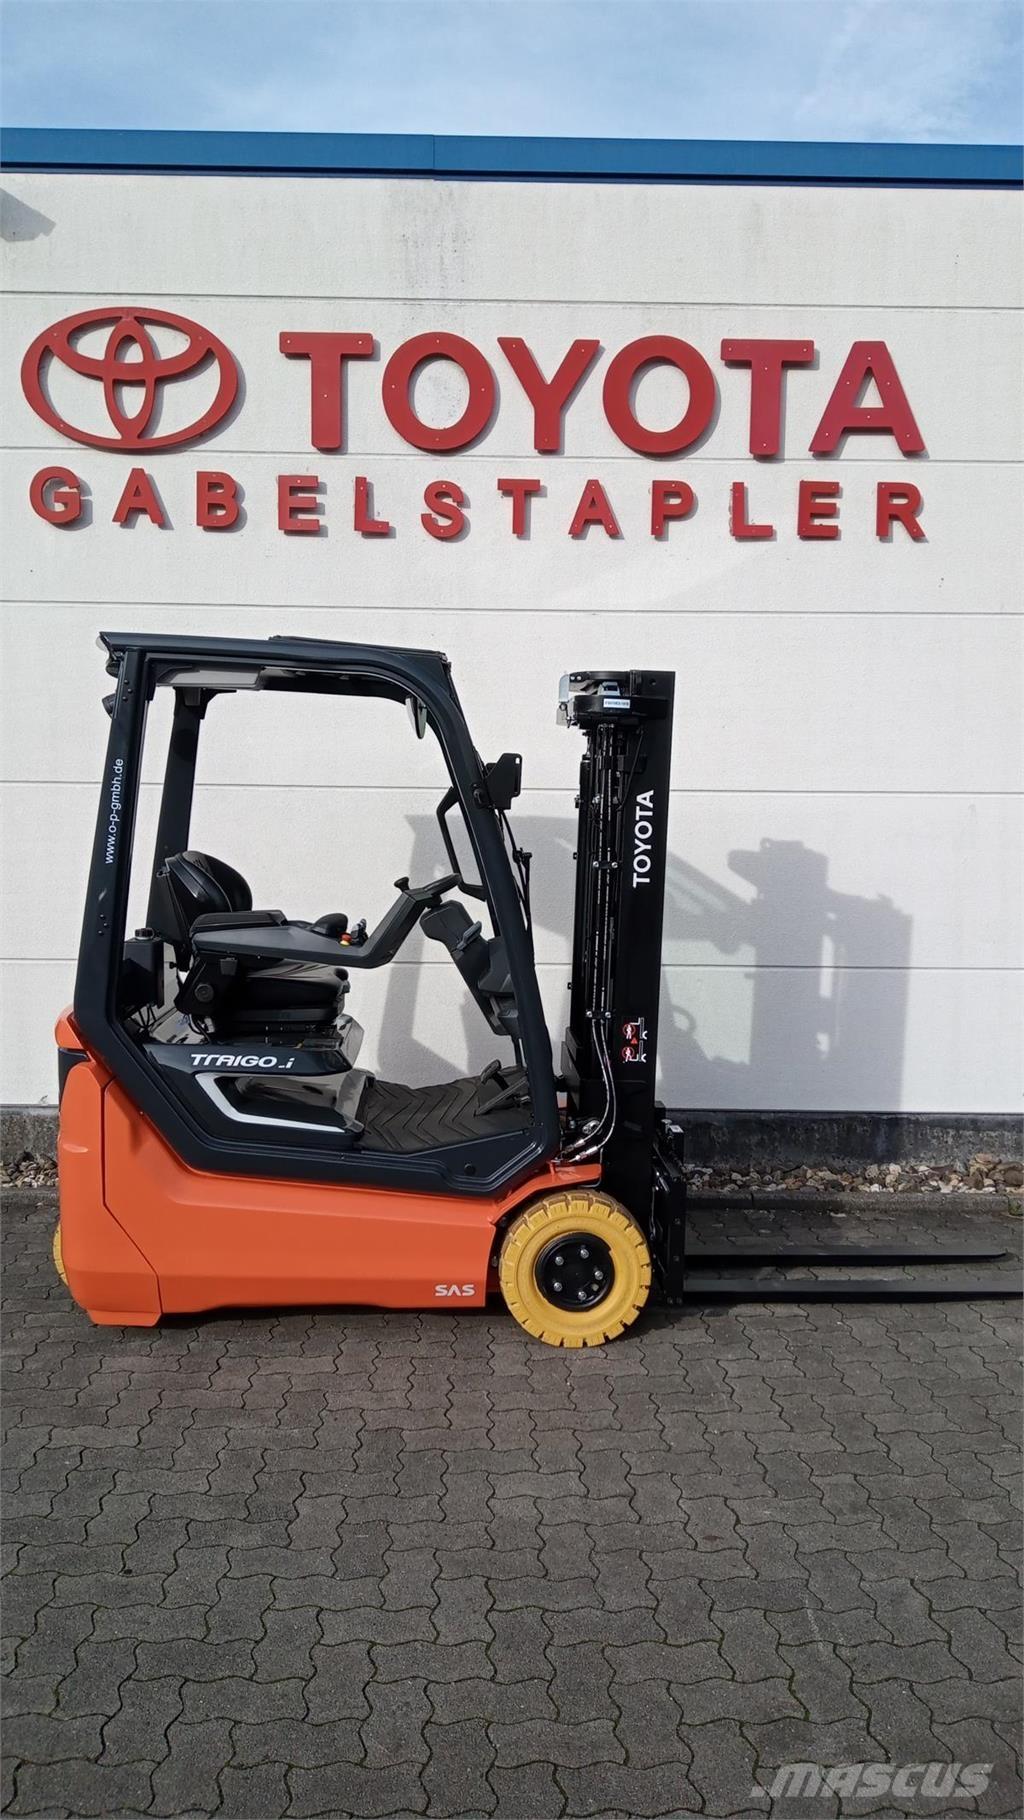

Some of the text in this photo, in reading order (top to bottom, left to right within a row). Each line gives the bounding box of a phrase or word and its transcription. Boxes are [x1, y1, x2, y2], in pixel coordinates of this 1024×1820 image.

[279, 331, 926, 456] TOYOTA
[29, 466, 927, 539] GABELSTAPLER
[104, 757, 124, 864] www.o-p-gmbh.de
[632, 789, 654, 888] TOYOTA
[434, 1284, 476, 1297] SAS
